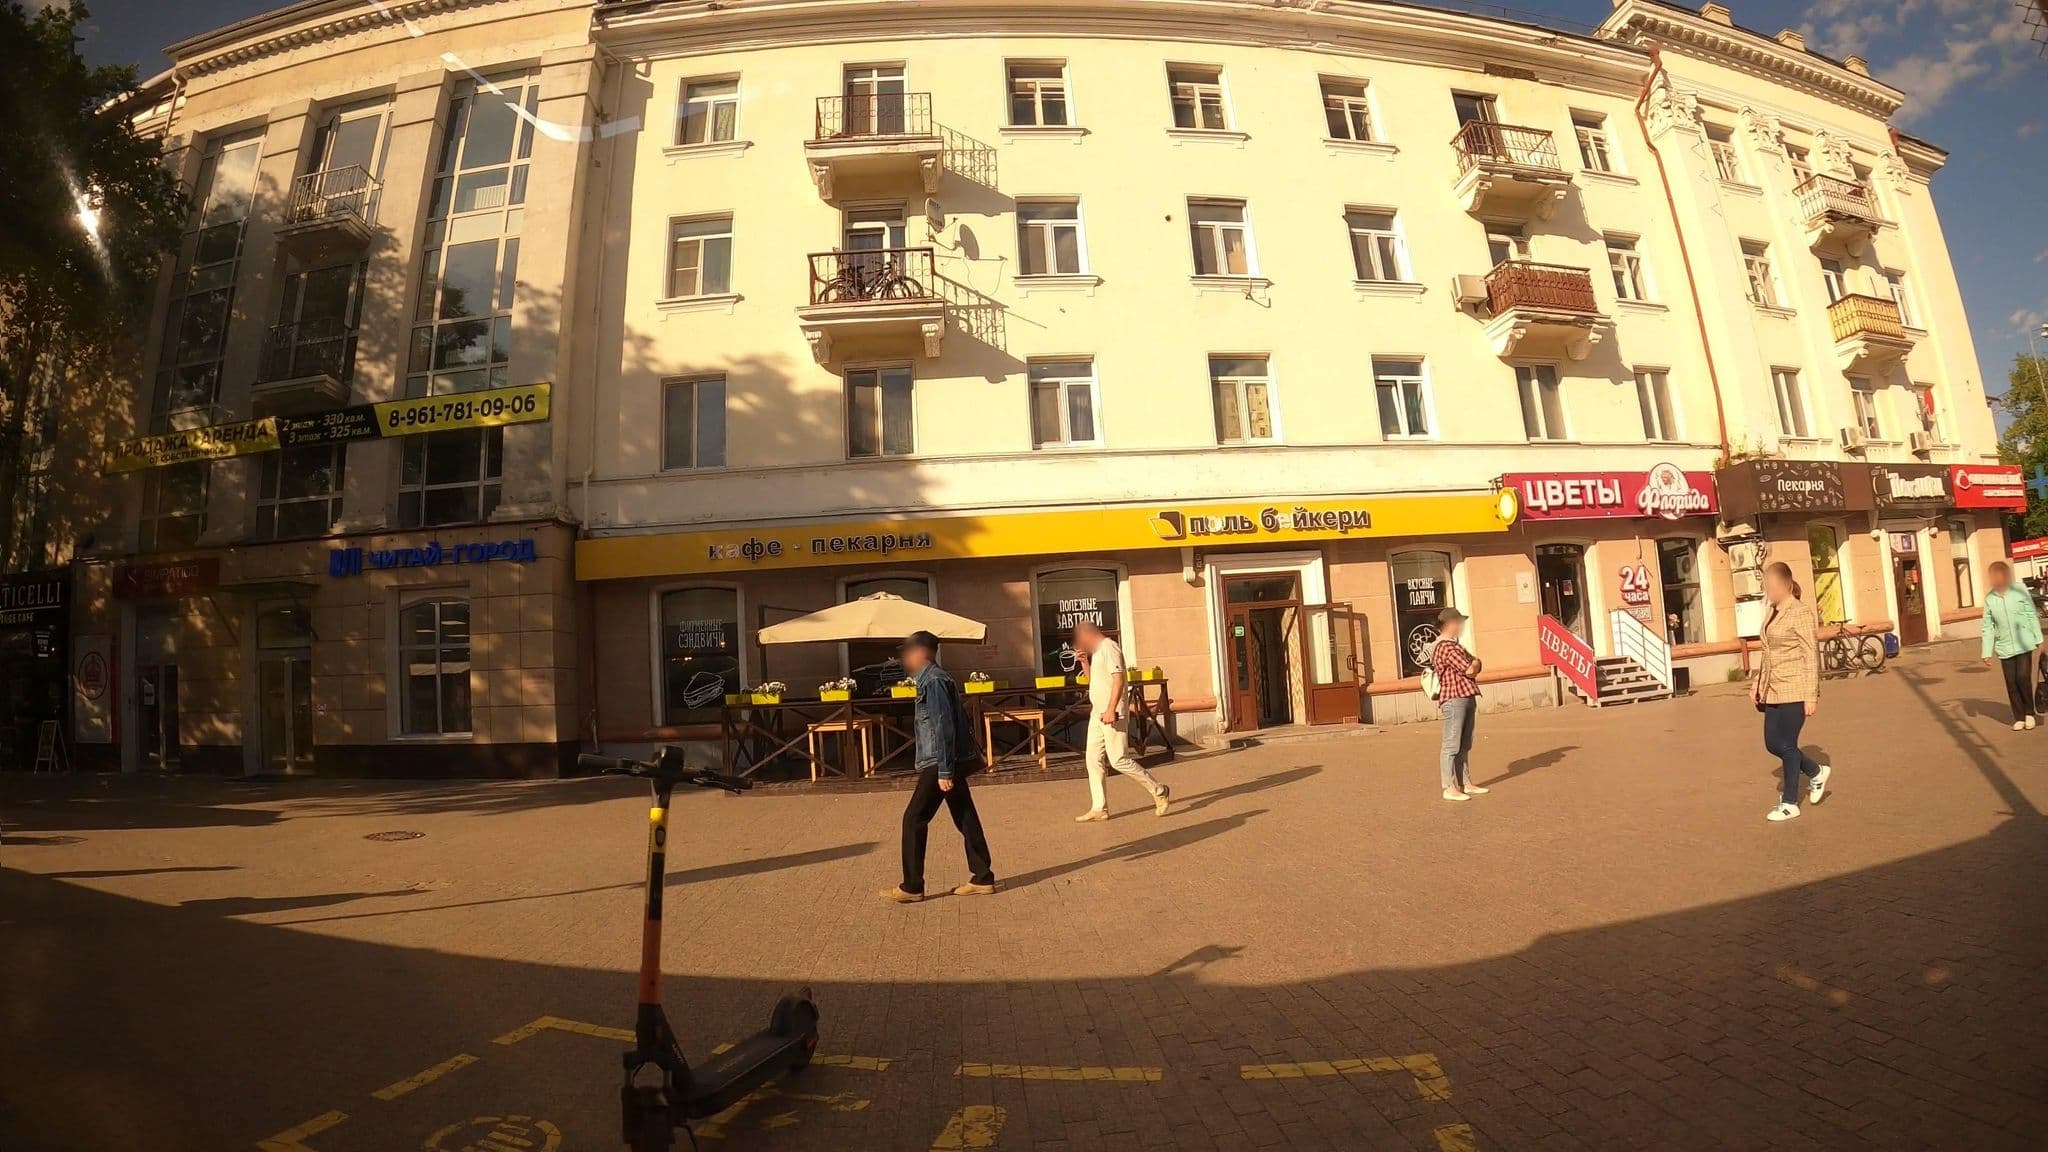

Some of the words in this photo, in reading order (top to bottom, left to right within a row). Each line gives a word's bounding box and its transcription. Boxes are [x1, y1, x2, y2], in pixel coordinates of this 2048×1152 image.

[282, 418, 292, 432] 2
[323, 413, 345, 426] 330
[388, 395, 536, 428] 8-961-781-09-06
[114, 435, 189, 460] ПРОДАЖА
[200, 422, 268, 445] АРЕНДА
[288, 432, 297, 444] 3
[329, 425, 351, 438] 325
[1524, 480, 1624, 512] ЦВЕТЫ
[1637, 485, 1710, 515] Флорида
[1777, 479, 1825, 499] Пекарня
[1189, 514, 1258, 533] поль
[1260, 506, 1370, 533] бейкери
[368, 539, 537, 569] ЧИТАЙ-ГОРОД
[708, 537, 783, 561] кафе
[811, 532, 932, 553] пекарня
[1620, 566, 1649, 591] 24
[0, 582, 61, 609] TICELLI
[1059, 598, 1098, 612] ПОЛЕЗНЫЕ
[1623, 591, 1650, 604] часа
[1056, 611, 1104, 629] ЗАВТРАКИ
[678, 632, 725, 649] СЭНДВИЧИ
[1540, 626, 1593, 680] ЦВЕТЫ
